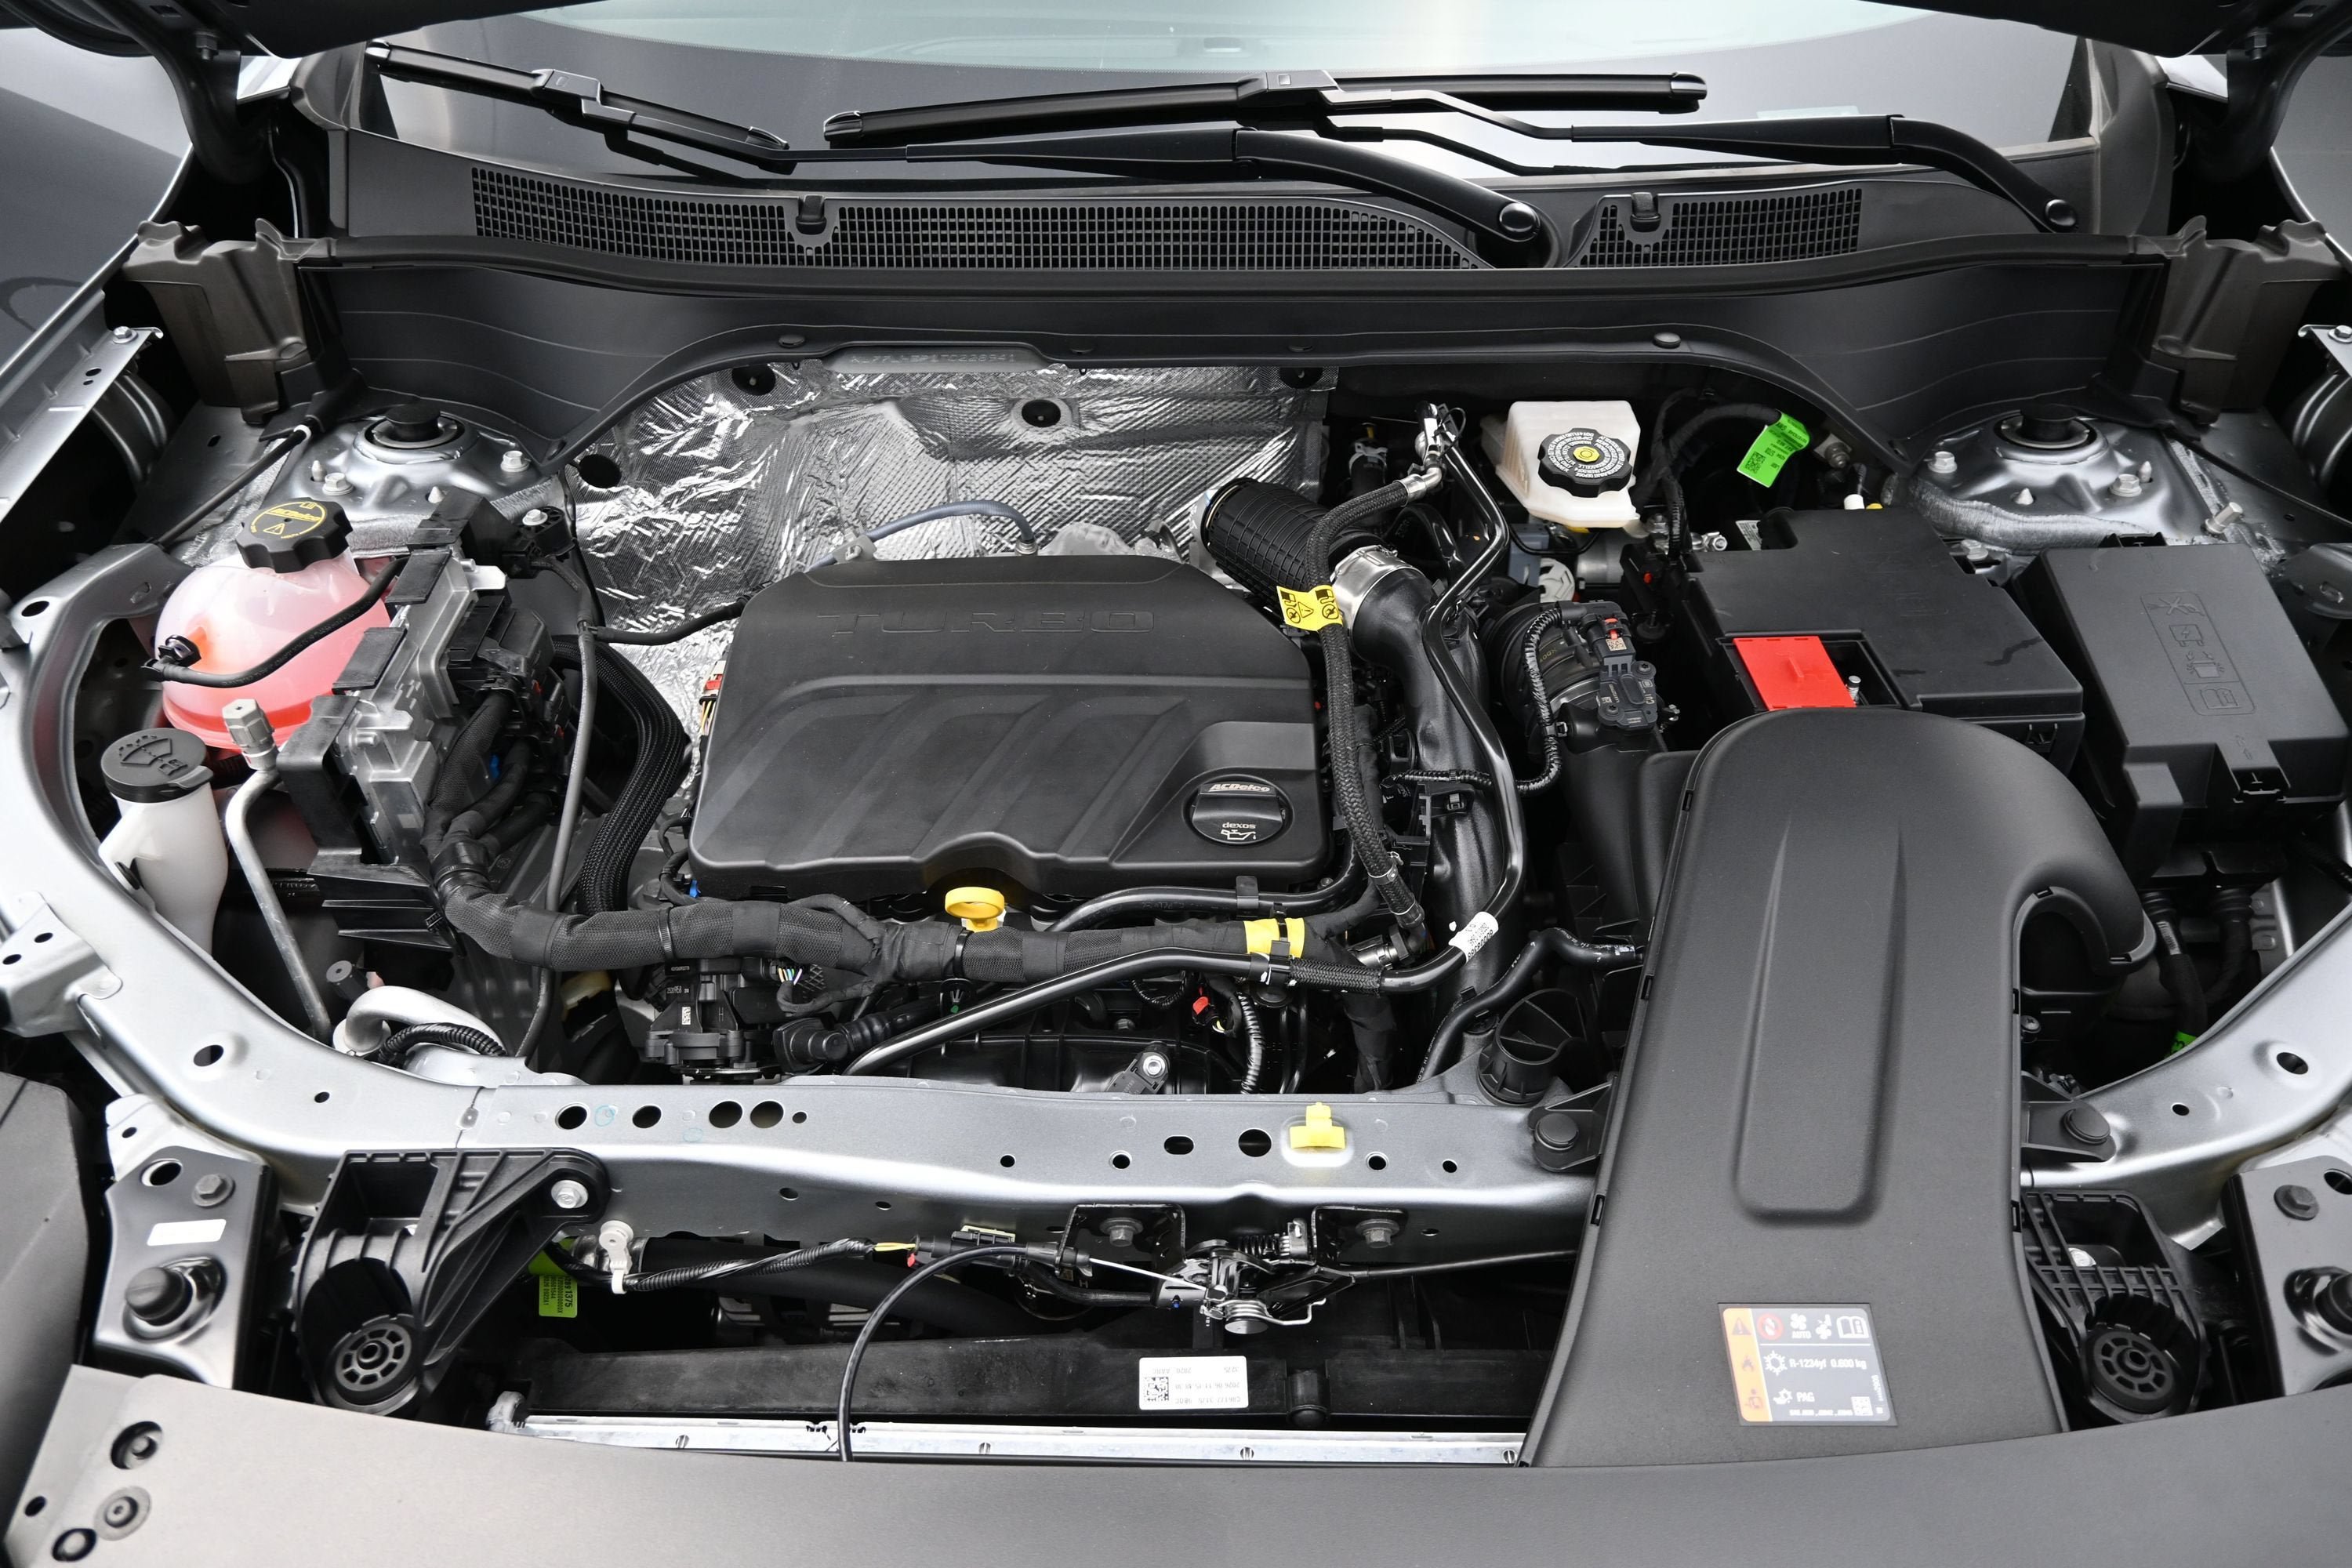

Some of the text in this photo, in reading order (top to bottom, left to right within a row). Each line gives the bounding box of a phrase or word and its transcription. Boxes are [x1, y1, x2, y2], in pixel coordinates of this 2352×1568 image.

[817, 611, 1155, 633] TURBO
[1208, 783, 1270, 793] ACDelco
[1791, 1330, 1811, 1339] AUTO
[1855, 1359, 1867, 1370] kg
[1796, 1392, 1815, 1402] PAG
